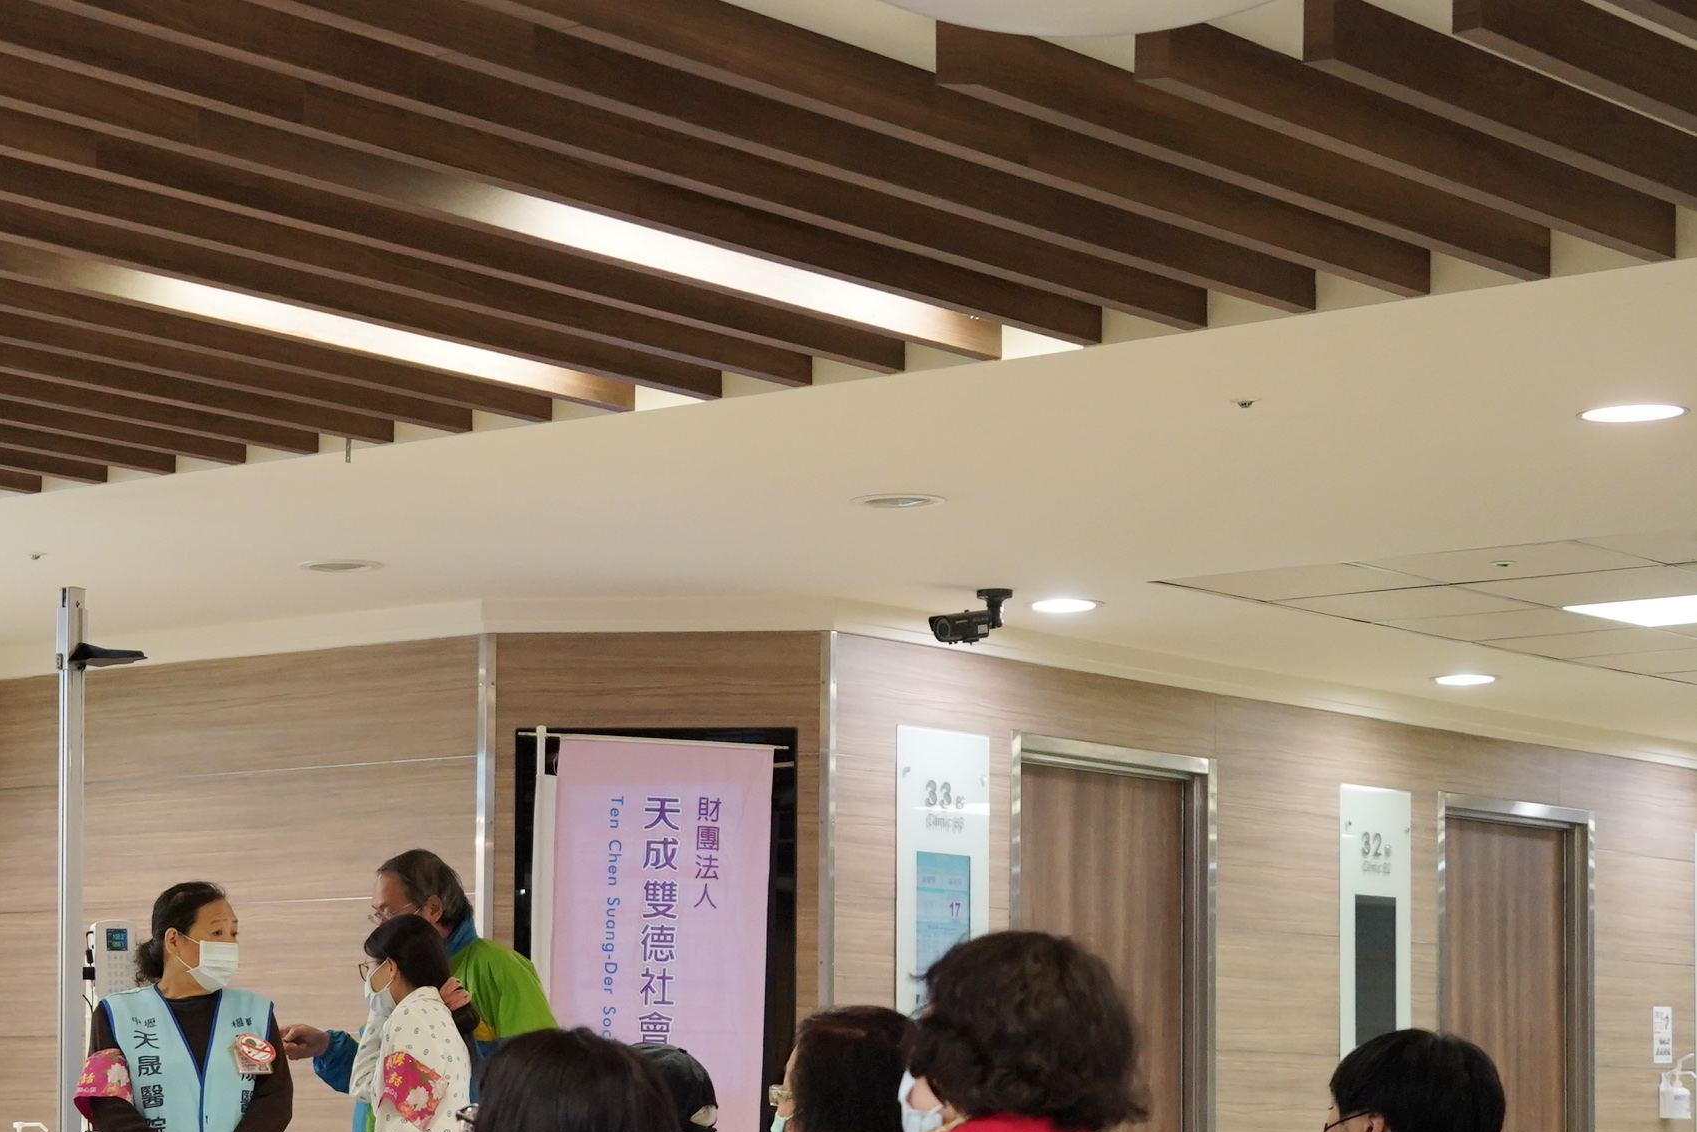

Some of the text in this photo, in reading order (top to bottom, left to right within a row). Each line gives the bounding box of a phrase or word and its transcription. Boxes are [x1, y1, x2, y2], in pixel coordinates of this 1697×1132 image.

[609, 796, 624, 828] Ten
[607, 839, 622, 886] Chen
[694, 796, 722, 910] 財團法人
[1361, 831, 1392, 858] 32
[638, 795, 682, 1044] 天成雙德社會
[949, 901, 961, 918] 17
[601, 896, 621, 995] Suang-Der
